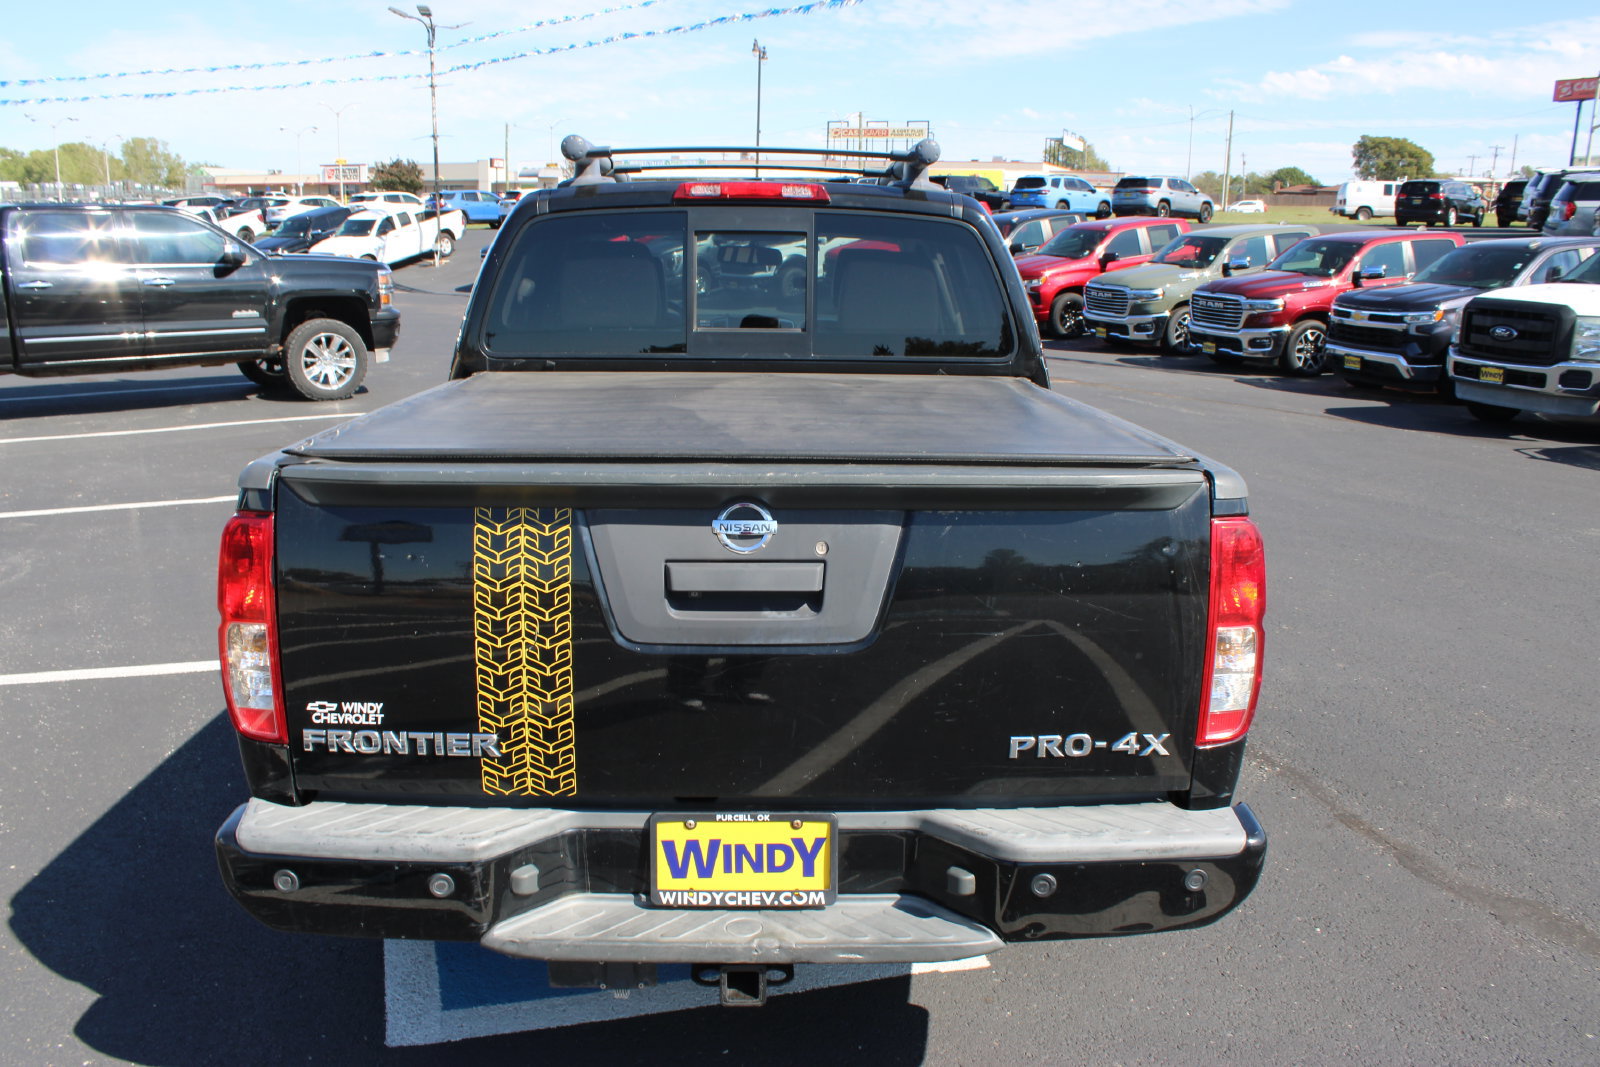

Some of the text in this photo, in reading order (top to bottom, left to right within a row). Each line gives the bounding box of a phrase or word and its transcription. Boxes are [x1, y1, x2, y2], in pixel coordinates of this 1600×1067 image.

[1200, 300, 1224, 309] RAM
[720, 523, 771, 532] NISSAN
[341, 701, 384, 714] WINDY
[311, 713, 384, 725] CHEVROLET
[302, 728, 502, 758] FRONTIER
[1008, 732, 1171, 759] PRO-4X
[715, 814, 754, 822] PURCELL,
[661, 837, 827, 879] WINDY
[658, 891, 826, 905] WINDYCHEV.COM
